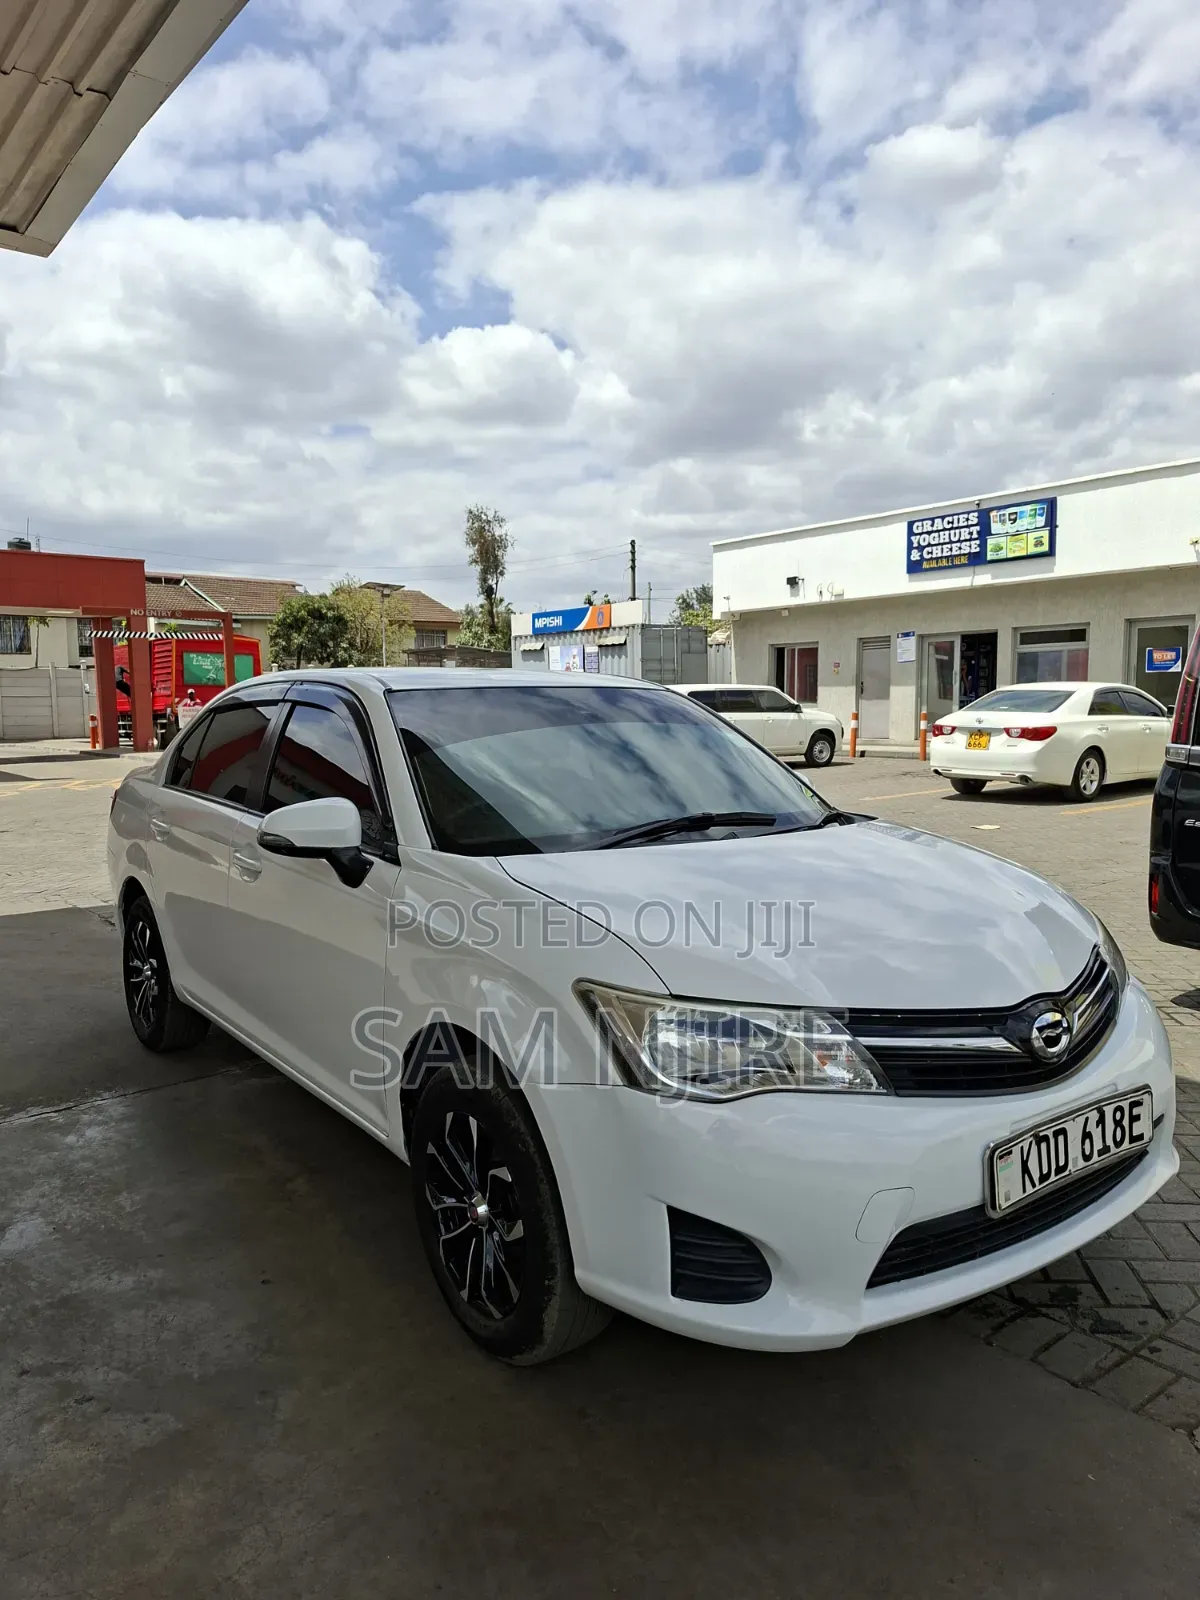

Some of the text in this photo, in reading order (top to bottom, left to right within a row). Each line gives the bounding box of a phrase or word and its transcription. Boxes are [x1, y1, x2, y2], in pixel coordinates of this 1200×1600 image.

[913, 512, 979, 534] GRACIES
[911, 527, 981, 547] YOGHURT
[910, 541, 980, 561] & CHEESE
[922, 555, 969, 569] AVAILABLE HERE
[130, 608, 173, 617] NO ENTRY
[534, 615, 562, 628] MPISHI
[1153, 652, 1162, 660] TO
[1020, 1126, 1070, 1194] KDD
[1080, 1097, 1146, 1164] 618E
